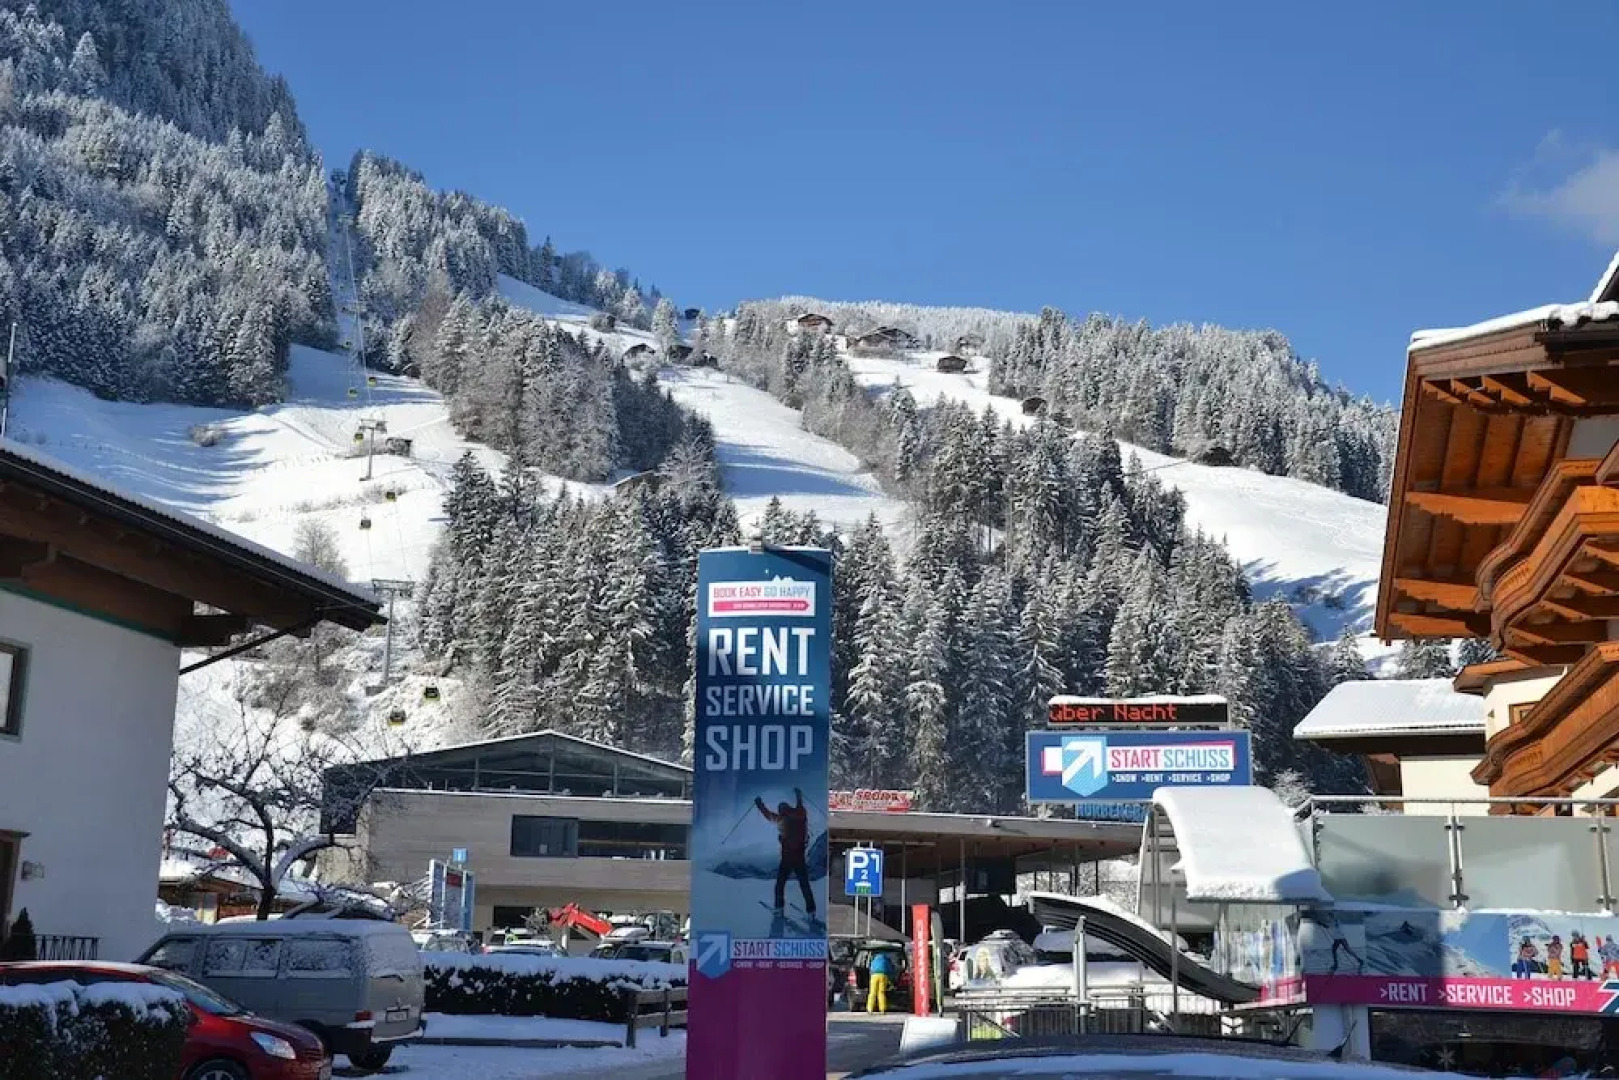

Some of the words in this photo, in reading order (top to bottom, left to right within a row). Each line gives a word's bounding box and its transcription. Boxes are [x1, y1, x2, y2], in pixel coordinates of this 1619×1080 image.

[714, 587, 737, 598] BOOK
[740, 586, 761, 597] EASY
[764, 586, 777, 597] GO
[780, 586, 809, 597] HAPPY
[708, 627, 815, 676] RENT
[706, 685, 814, 716] SERVICE
[1114, 702, 1177, 721] Nacht
[705, 725, 813, 771] SHOP
[848, 851, 869, 880] P
[861, 869, 869, 880] 2
